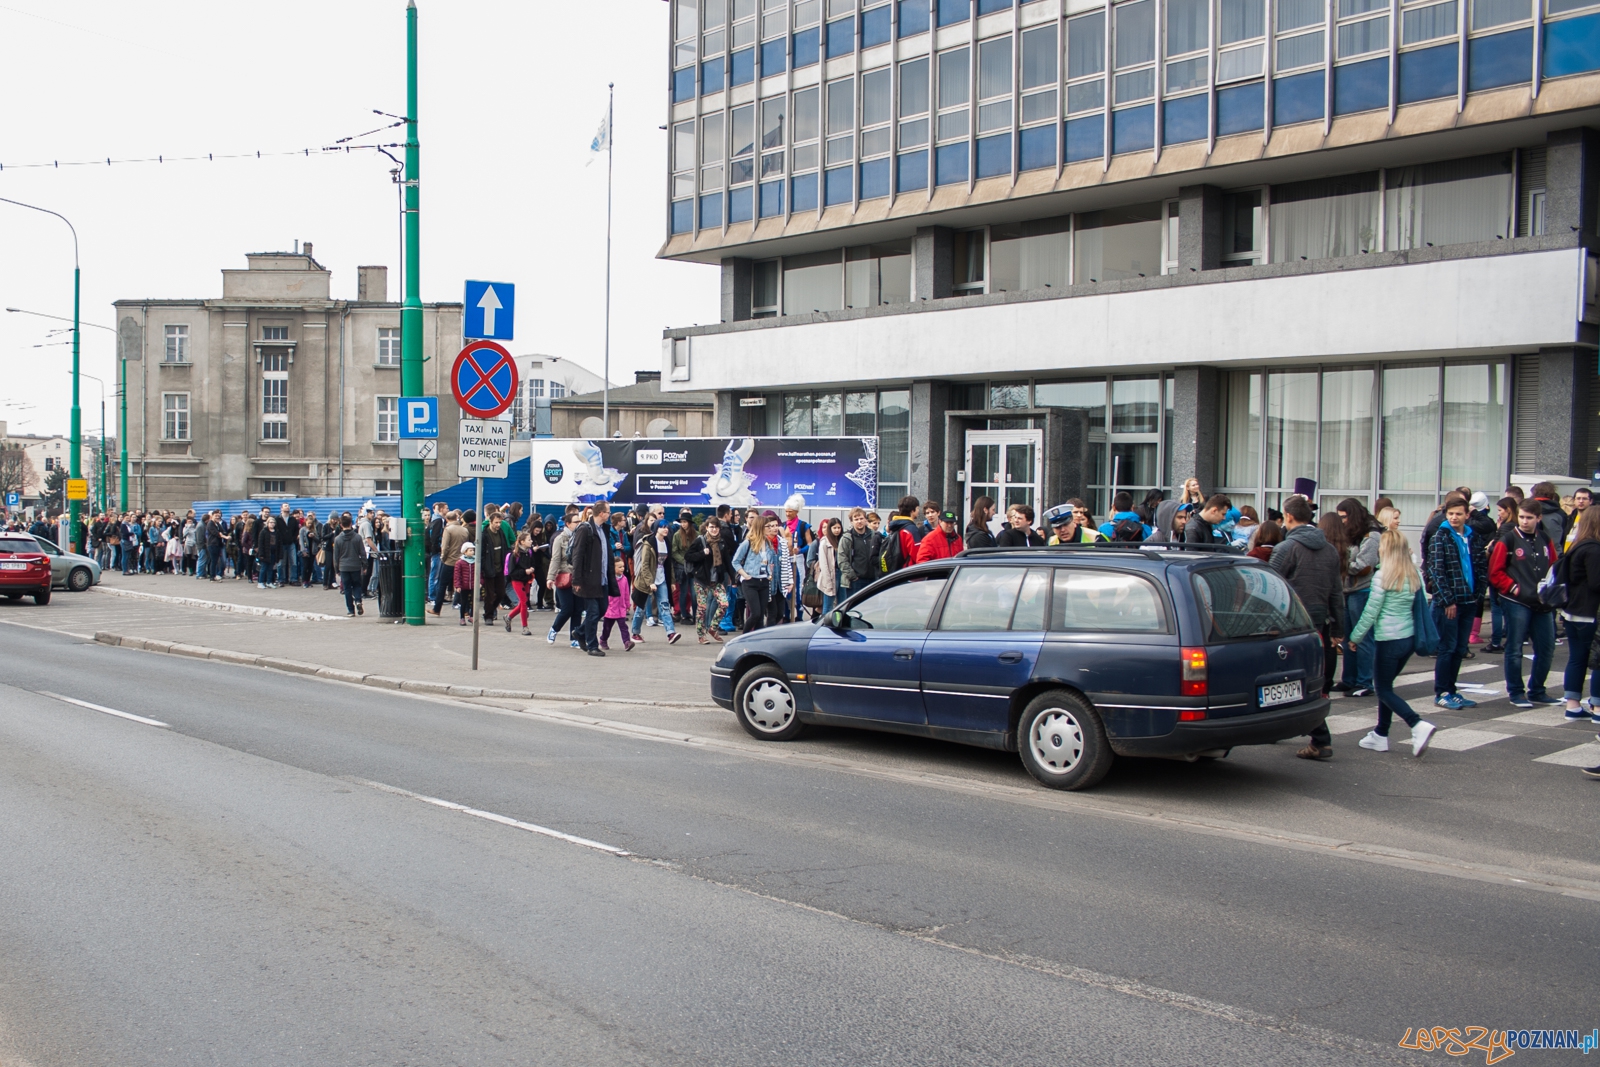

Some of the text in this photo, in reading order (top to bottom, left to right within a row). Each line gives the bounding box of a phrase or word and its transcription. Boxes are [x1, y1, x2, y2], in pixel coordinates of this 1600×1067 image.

[407, 401, 430, 433] P
[464, 424, 504, 434] TAXI NA
[461, 437, 507, 446] WEZWANIE
[463, 449, 505, 459] DO PIĘCIU
[470, 463, 496, 472] MINUT
[9, 495, 16, 503] P
[1264, 685, 1282, 702] PGS
